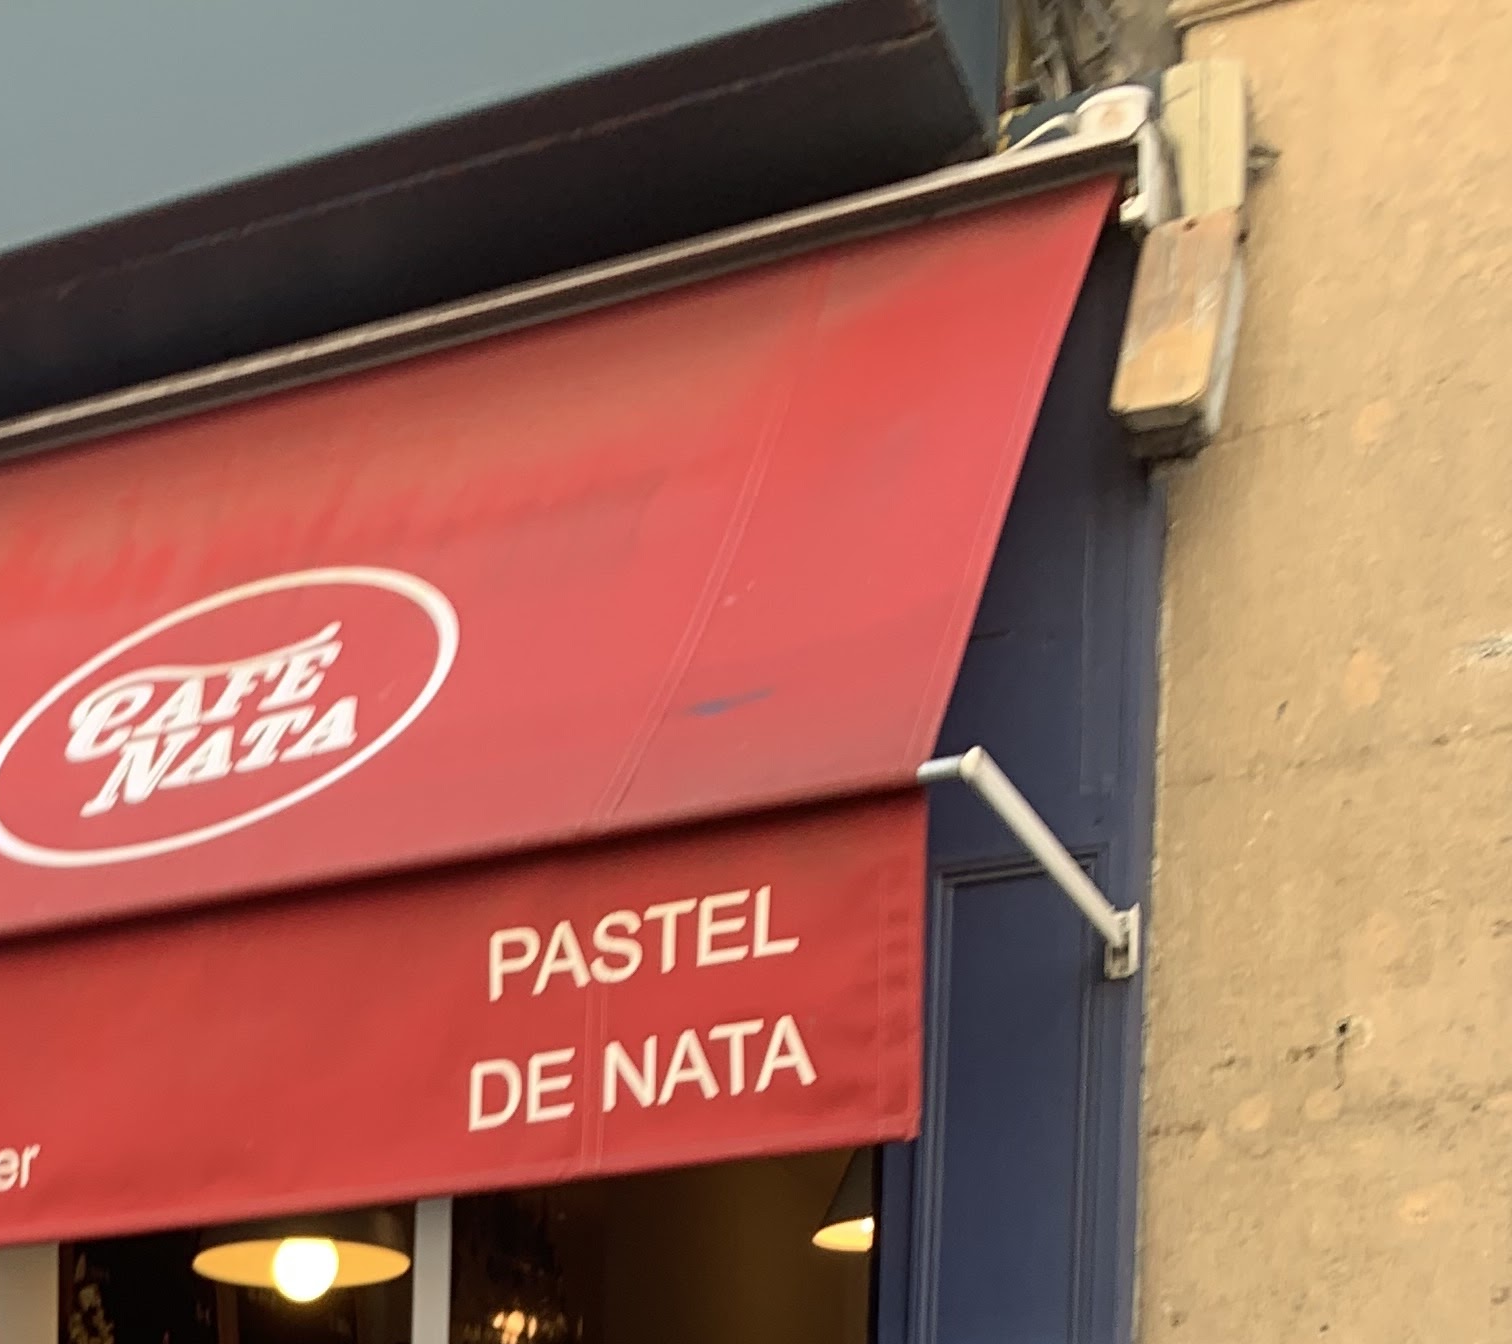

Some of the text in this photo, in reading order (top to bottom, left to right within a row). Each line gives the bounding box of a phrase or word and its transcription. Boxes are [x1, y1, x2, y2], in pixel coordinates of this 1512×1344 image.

[80, 695, 359, 818] NATA
[488, 884, 800, 1003] PASTEL
[468, 1014, 817, 1132] DE NATA
